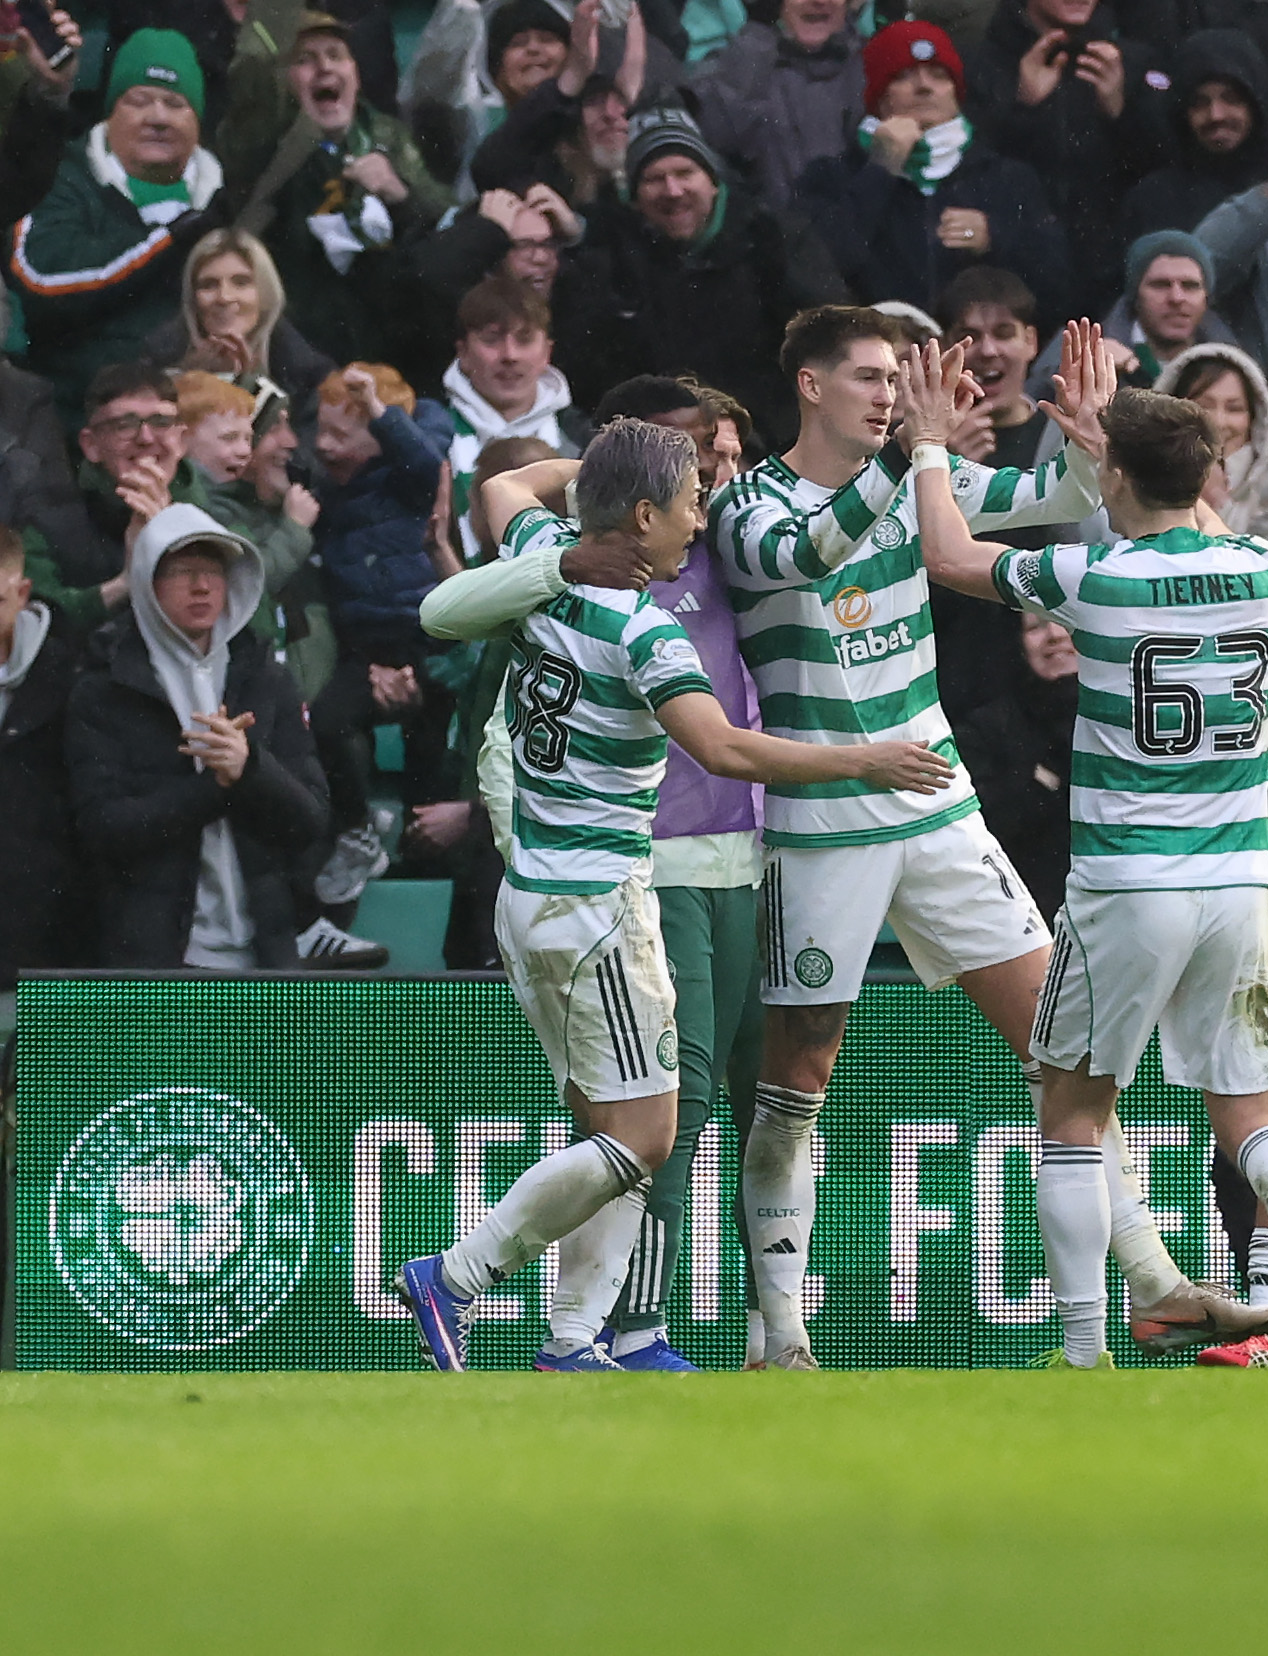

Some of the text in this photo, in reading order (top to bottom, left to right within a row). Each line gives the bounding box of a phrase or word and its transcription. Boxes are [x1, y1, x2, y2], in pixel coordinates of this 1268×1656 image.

[1145, 574, 1256, 606] TIERNEY
[834, 621, 913, 670] fabet
[757, 1207, 801, 1218] CELTIC
